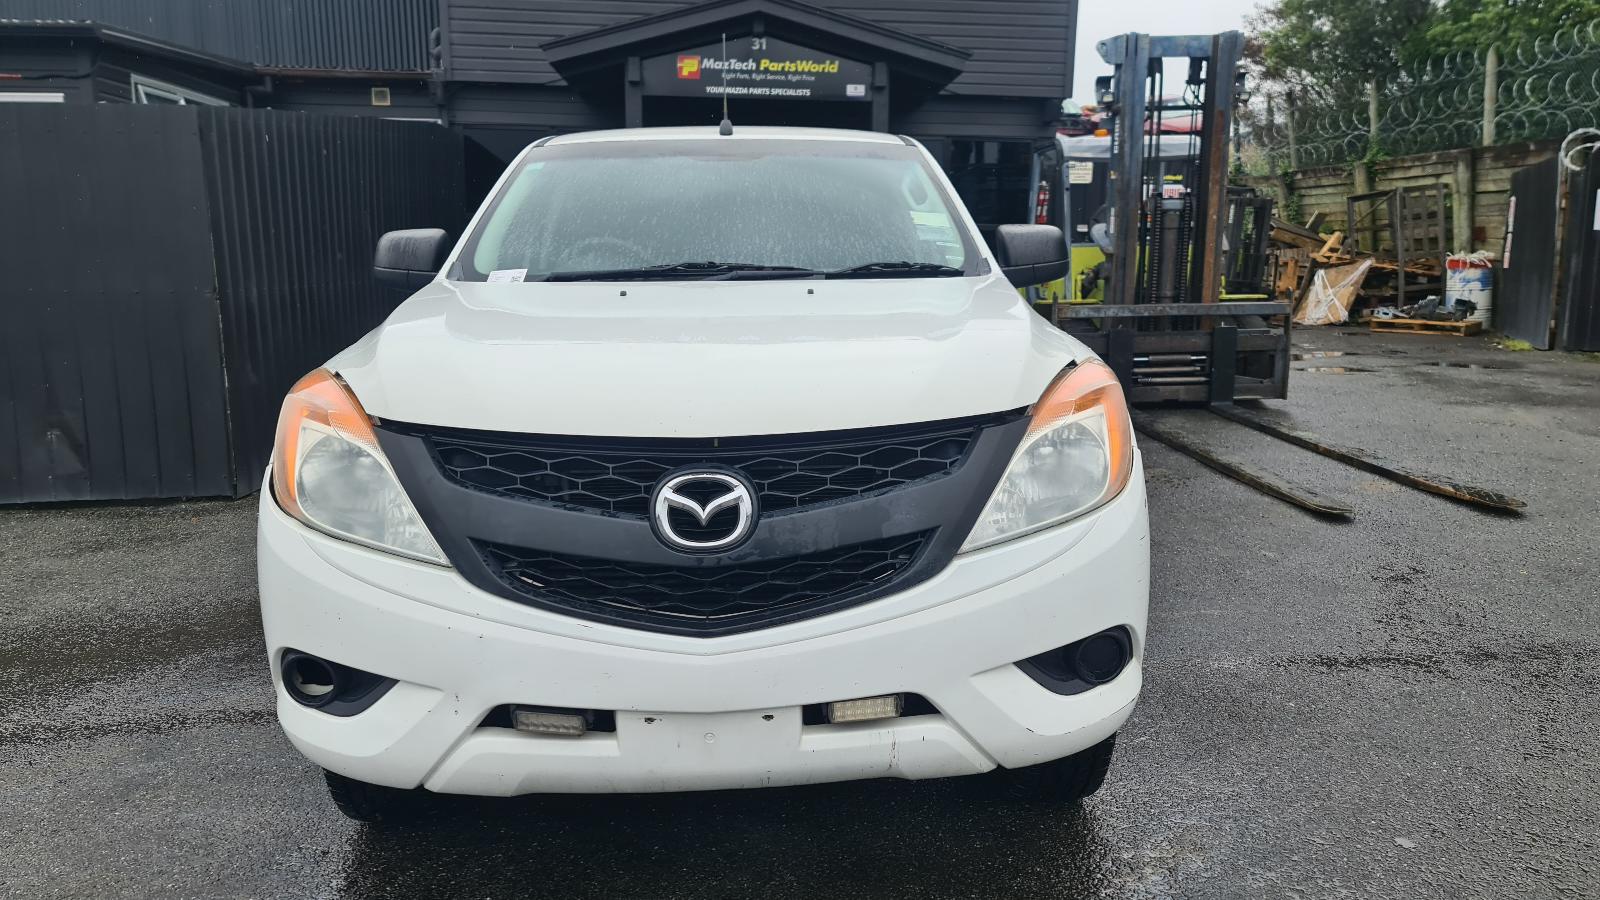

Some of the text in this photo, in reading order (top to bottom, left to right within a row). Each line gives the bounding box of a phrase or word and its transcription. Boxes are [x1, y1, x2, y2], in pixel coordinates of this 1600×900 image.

[751, 38, 767, 50] 31
[701, 58, 839, 73] MazTech PartsWorld
[752, 73, 766, 81] Right
[787, 74, 802, 82] Right
[706, 86, 724, 94] YOUR
[749, 87, 770, 96] PARTS
[771, 88, 811, 97] SPECIALISTS
